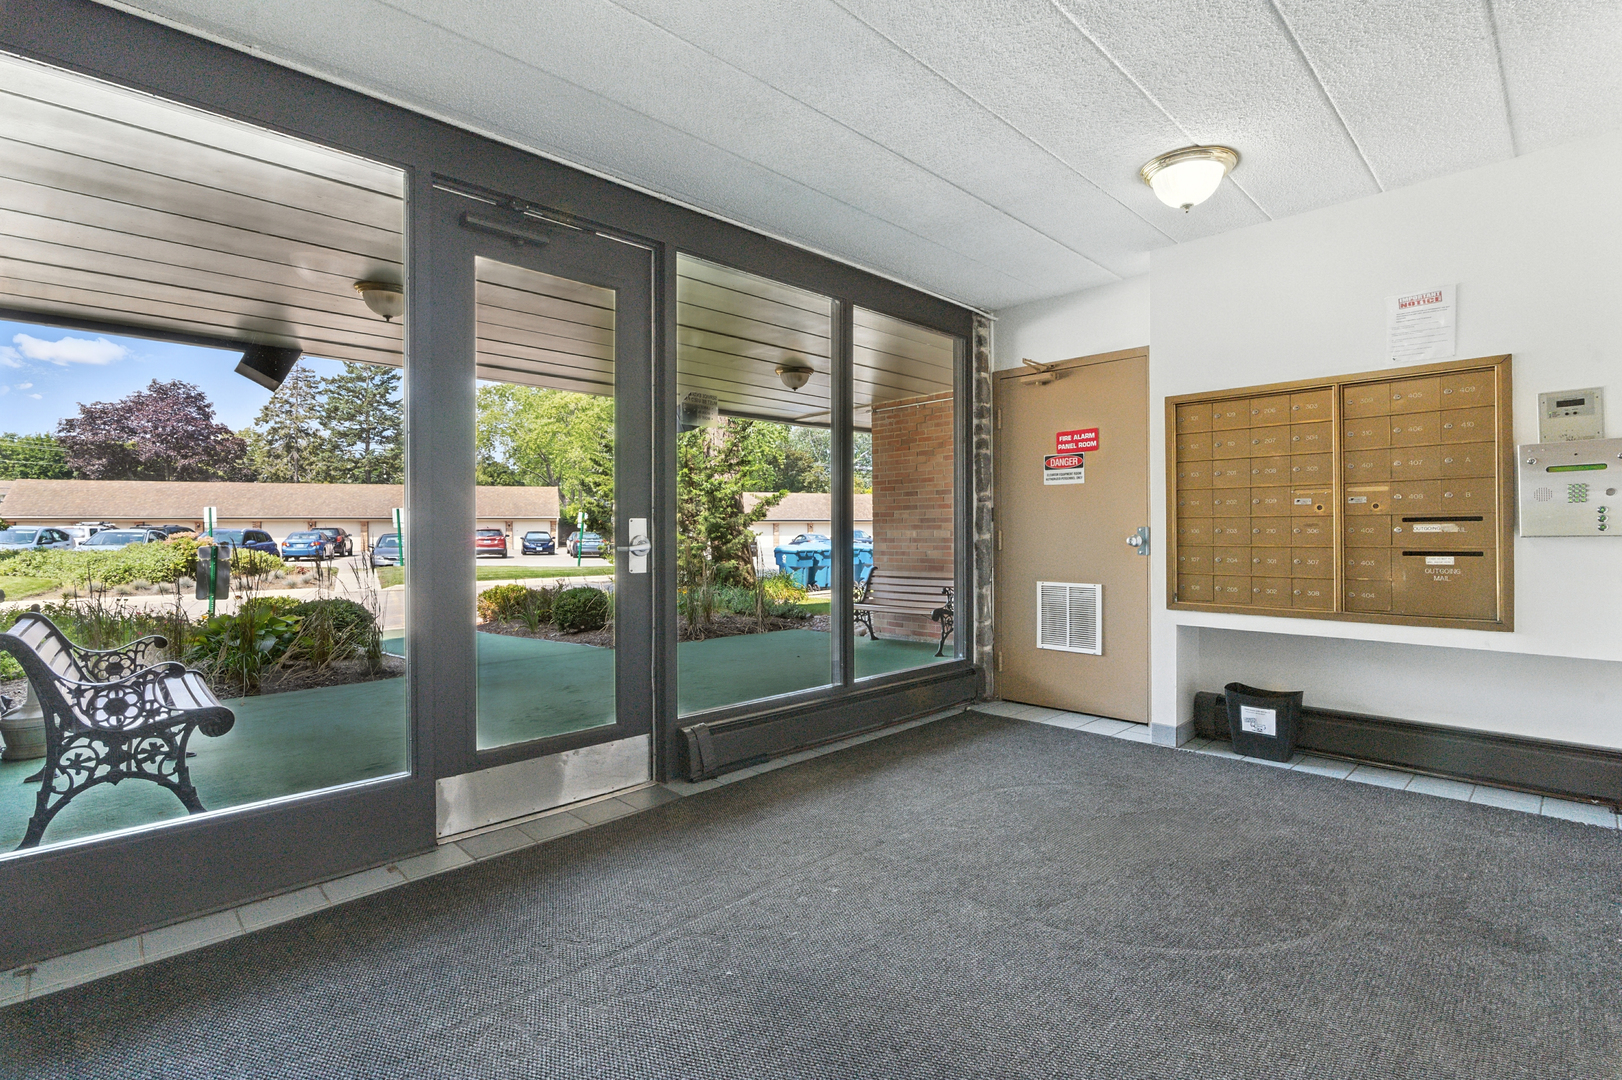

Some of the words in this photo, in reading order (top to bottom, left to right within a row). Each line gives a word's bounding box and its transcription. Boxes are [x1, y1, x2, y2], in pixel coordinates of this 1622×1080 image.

[1400, 292, 1440, 303] IMPORTANT
[1401, 297, 1441, 308] NOTICE
[1050, 458, 1078, 466] DANGER
